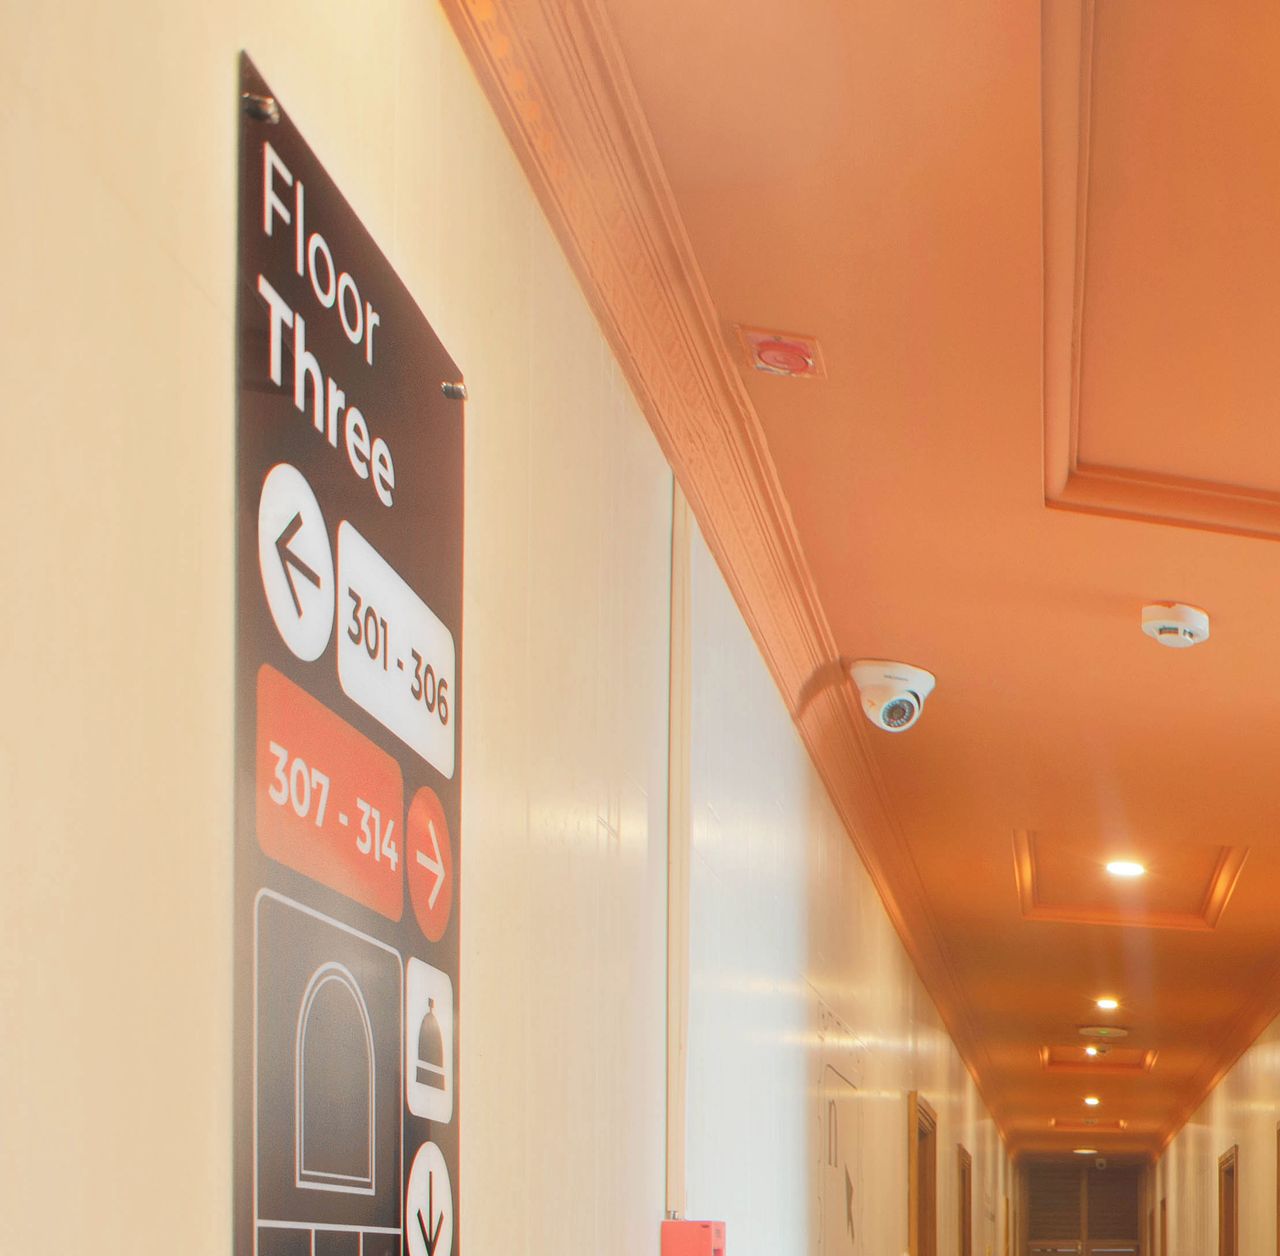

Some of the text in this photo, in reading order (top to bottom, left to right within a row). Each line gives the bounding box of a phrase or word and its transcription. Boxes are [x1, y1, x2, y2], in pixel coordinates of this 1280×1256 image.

[263, 140, 381, 367] Floor
[257, 273, 396, 508] Three
[346, 586, 389, 672] 301
[410, 647, 449, 726] 306
[268, 740, 330, 828] 307
[355, 797, 399, 872] 314
